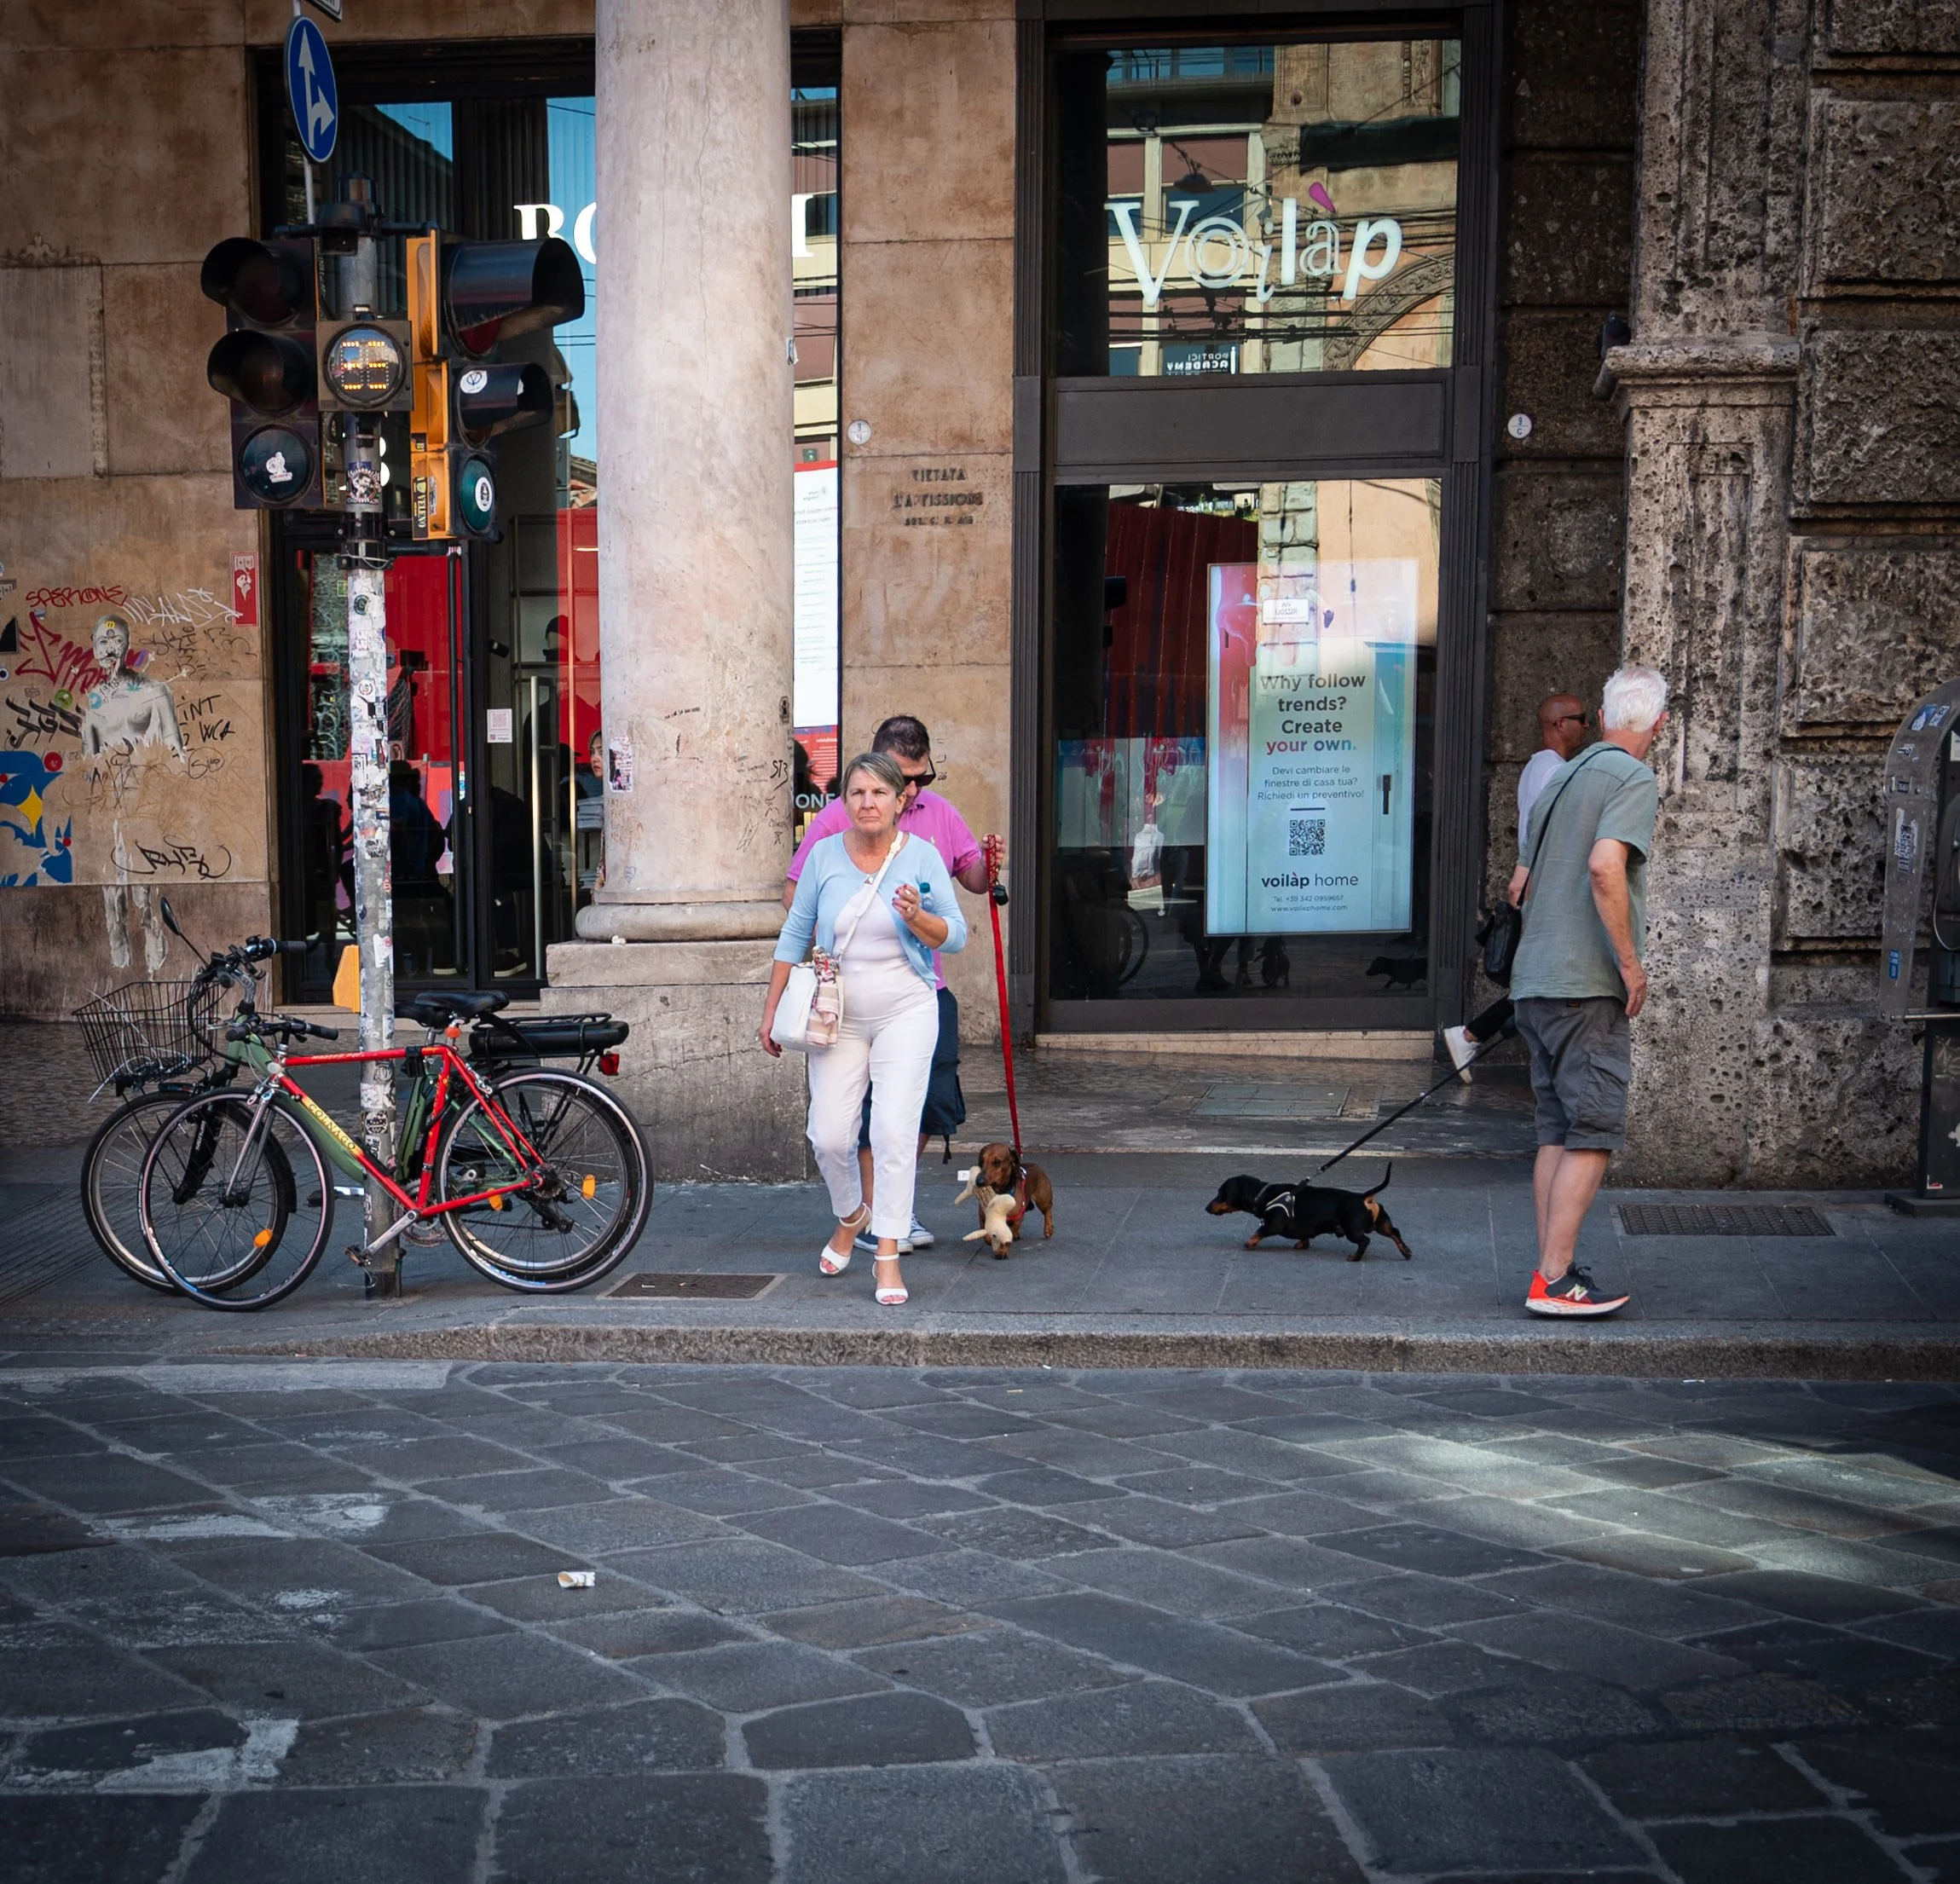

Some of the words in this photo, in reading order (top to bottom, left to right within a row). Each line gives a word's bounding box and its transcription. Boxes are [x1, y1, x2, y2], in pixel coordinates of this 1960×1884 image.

[1260, 675, 1303, 692] Why
[1308, 673, 1366, 689] follow
[1278, 696, 1347, 713] trends?
[1281, 719, 1343, 734] Create
[1266, 740, 1308, 756] your
[1314, 739, 1356, 751] own.
[1272, 766, 1293, 775] Devi
[1295, 766, 1339, 775] cambiare
[1342, 765, 1350, 773] le
[1264, 778, 1300, 788] finestre
[1302, 778, 1311, 787] di
[1338, 777, 1358, 786] tua?
[1258, 791, 1295, 800] Richiedi
[1312, 789, 1364, 800] preventivo!
[1261, 871, 1310, 889] voilàp
[1315, 874, 1359, 887] home
[309, 1103, 356, 1150] COLNAGO
